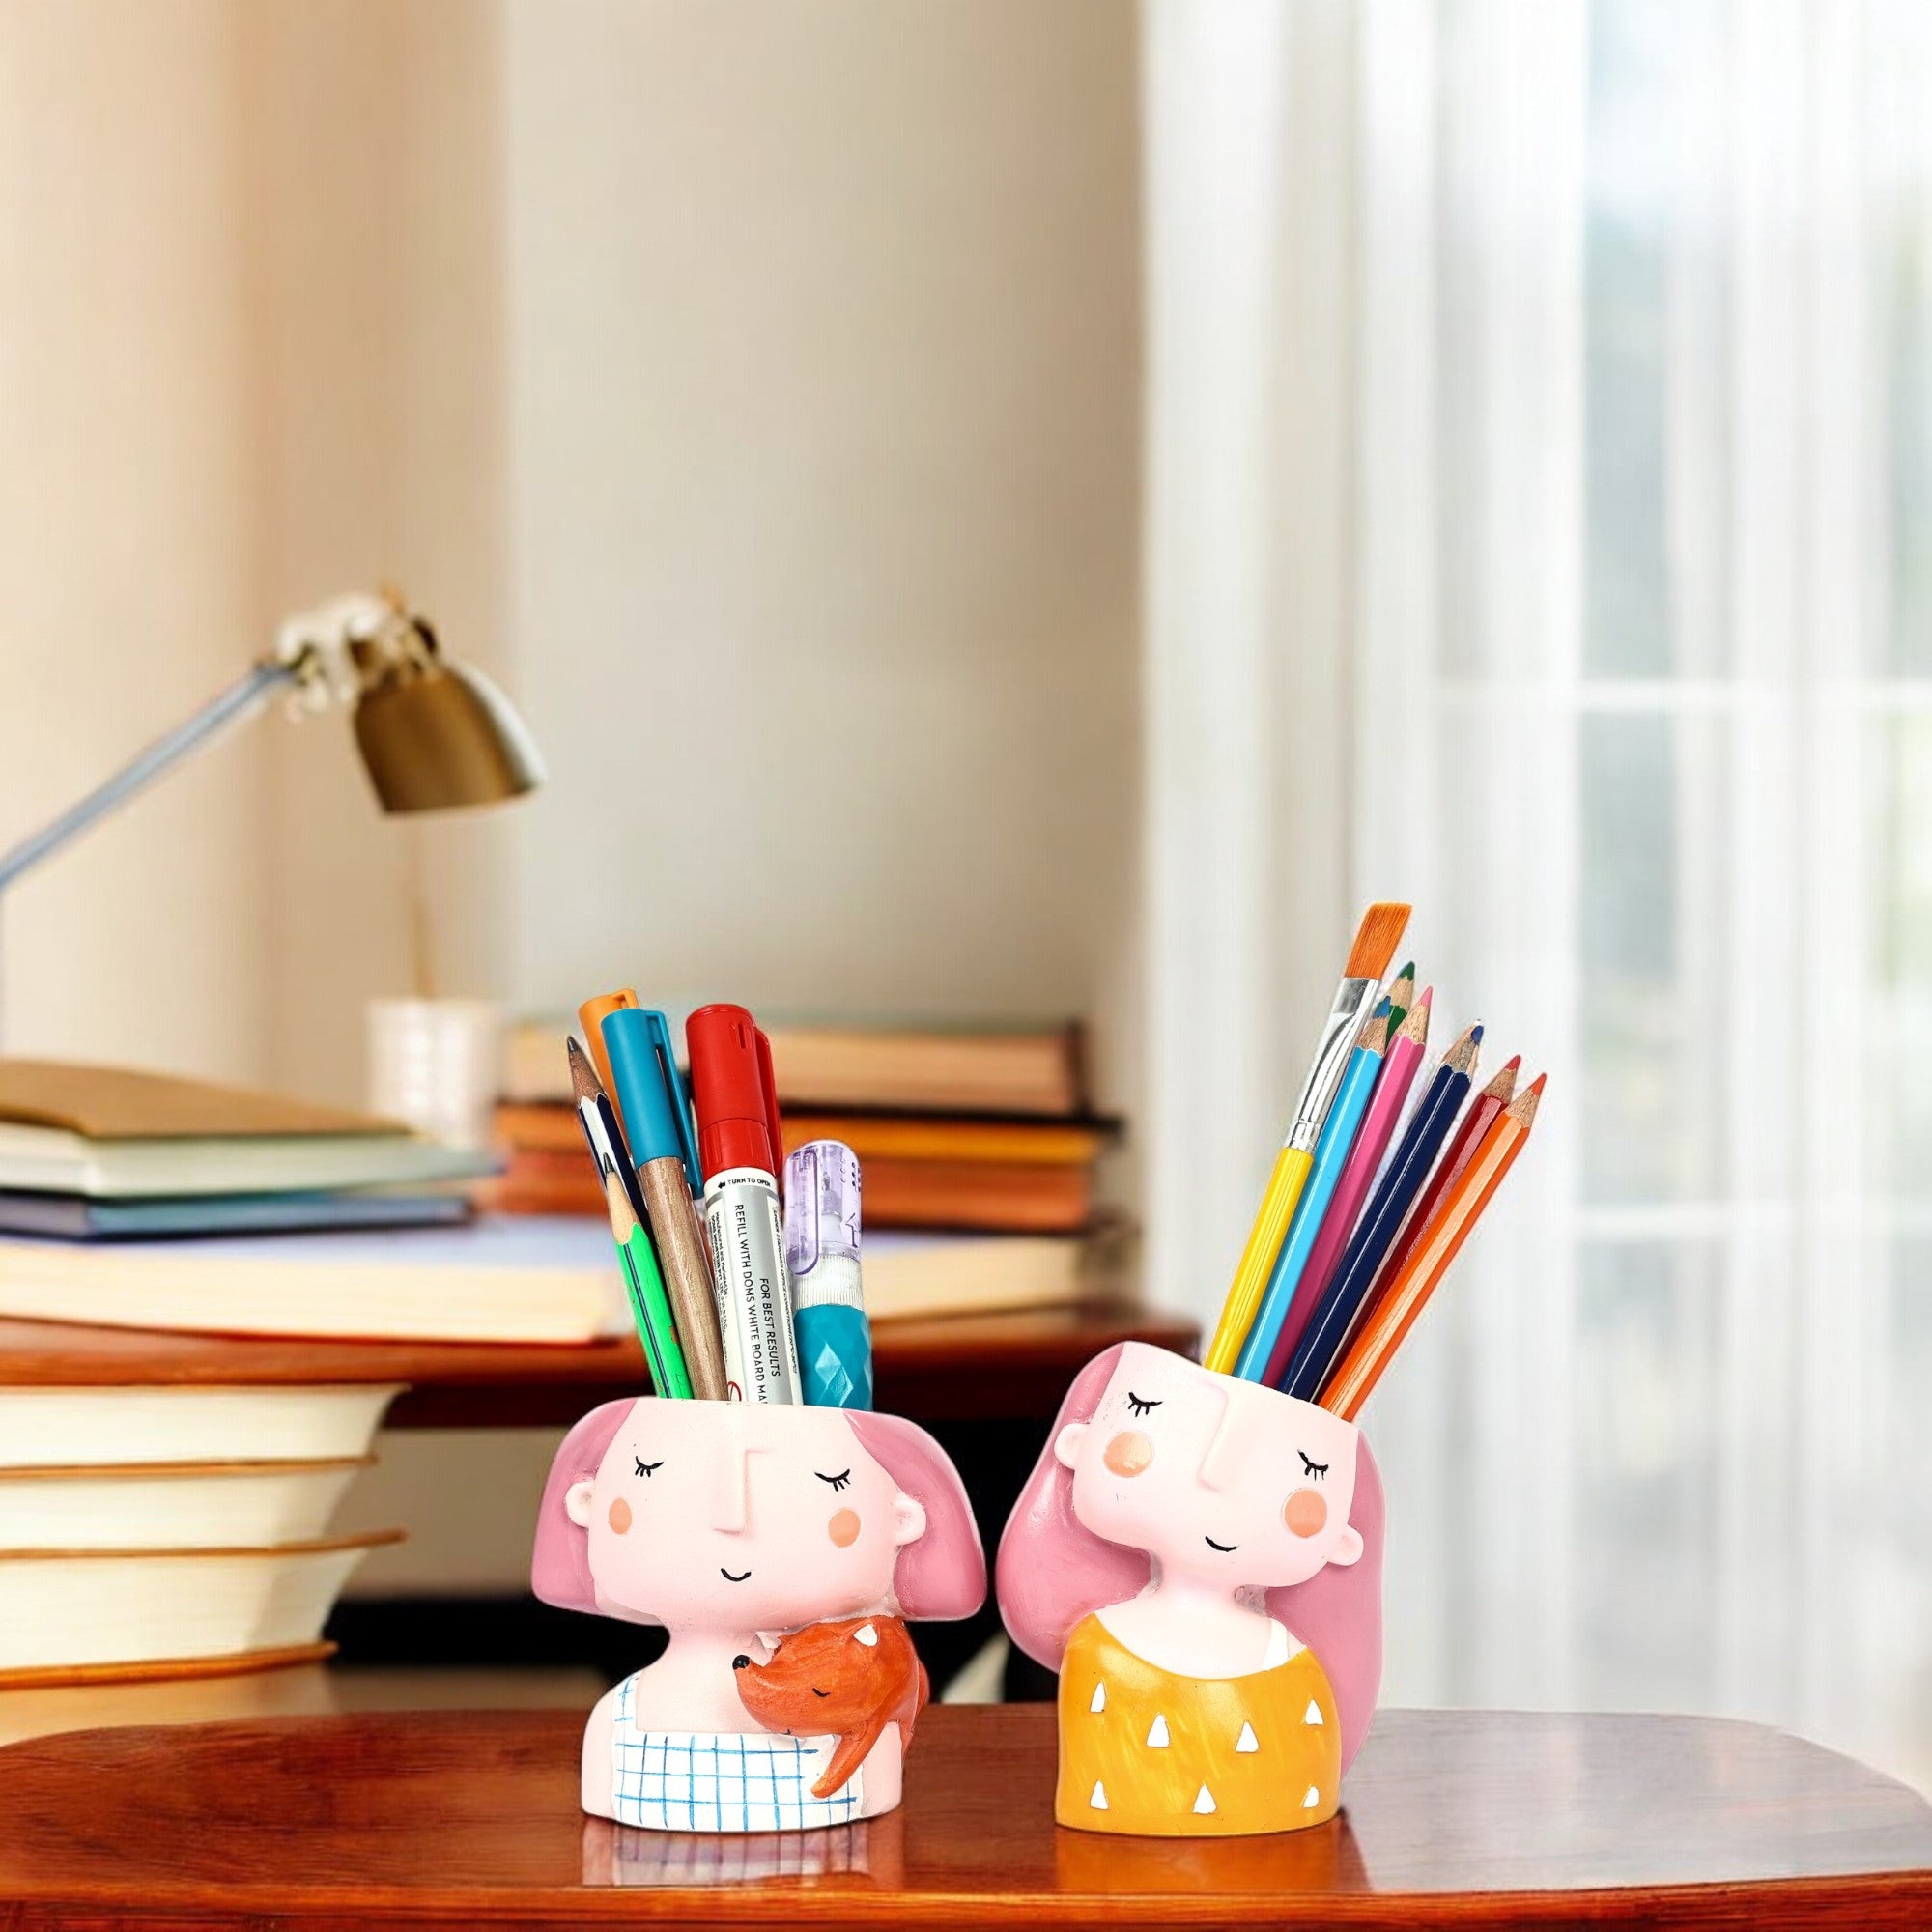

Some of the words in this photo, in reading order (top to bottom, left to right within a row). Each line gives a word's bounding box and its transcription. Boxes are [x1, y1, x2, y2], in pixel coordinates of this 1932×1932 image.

[757, 1179, 771, 1187] OPEN
[734, 1204, 748, 1237] REFILL
[740, 1239, 752, 1268] WITH
[743, 1271, 755, 1303] DOMS
[759, 1278, 771, 1299] FOR
[748, 1304, 760, 1341] WHITE
[762, 1302, 775, 1329] BEST
[752, 1344, 765, 1381] BOARD
[766, 1331, 781, 1377] RESULTS
[757, 1384, 768, 1404] MA
